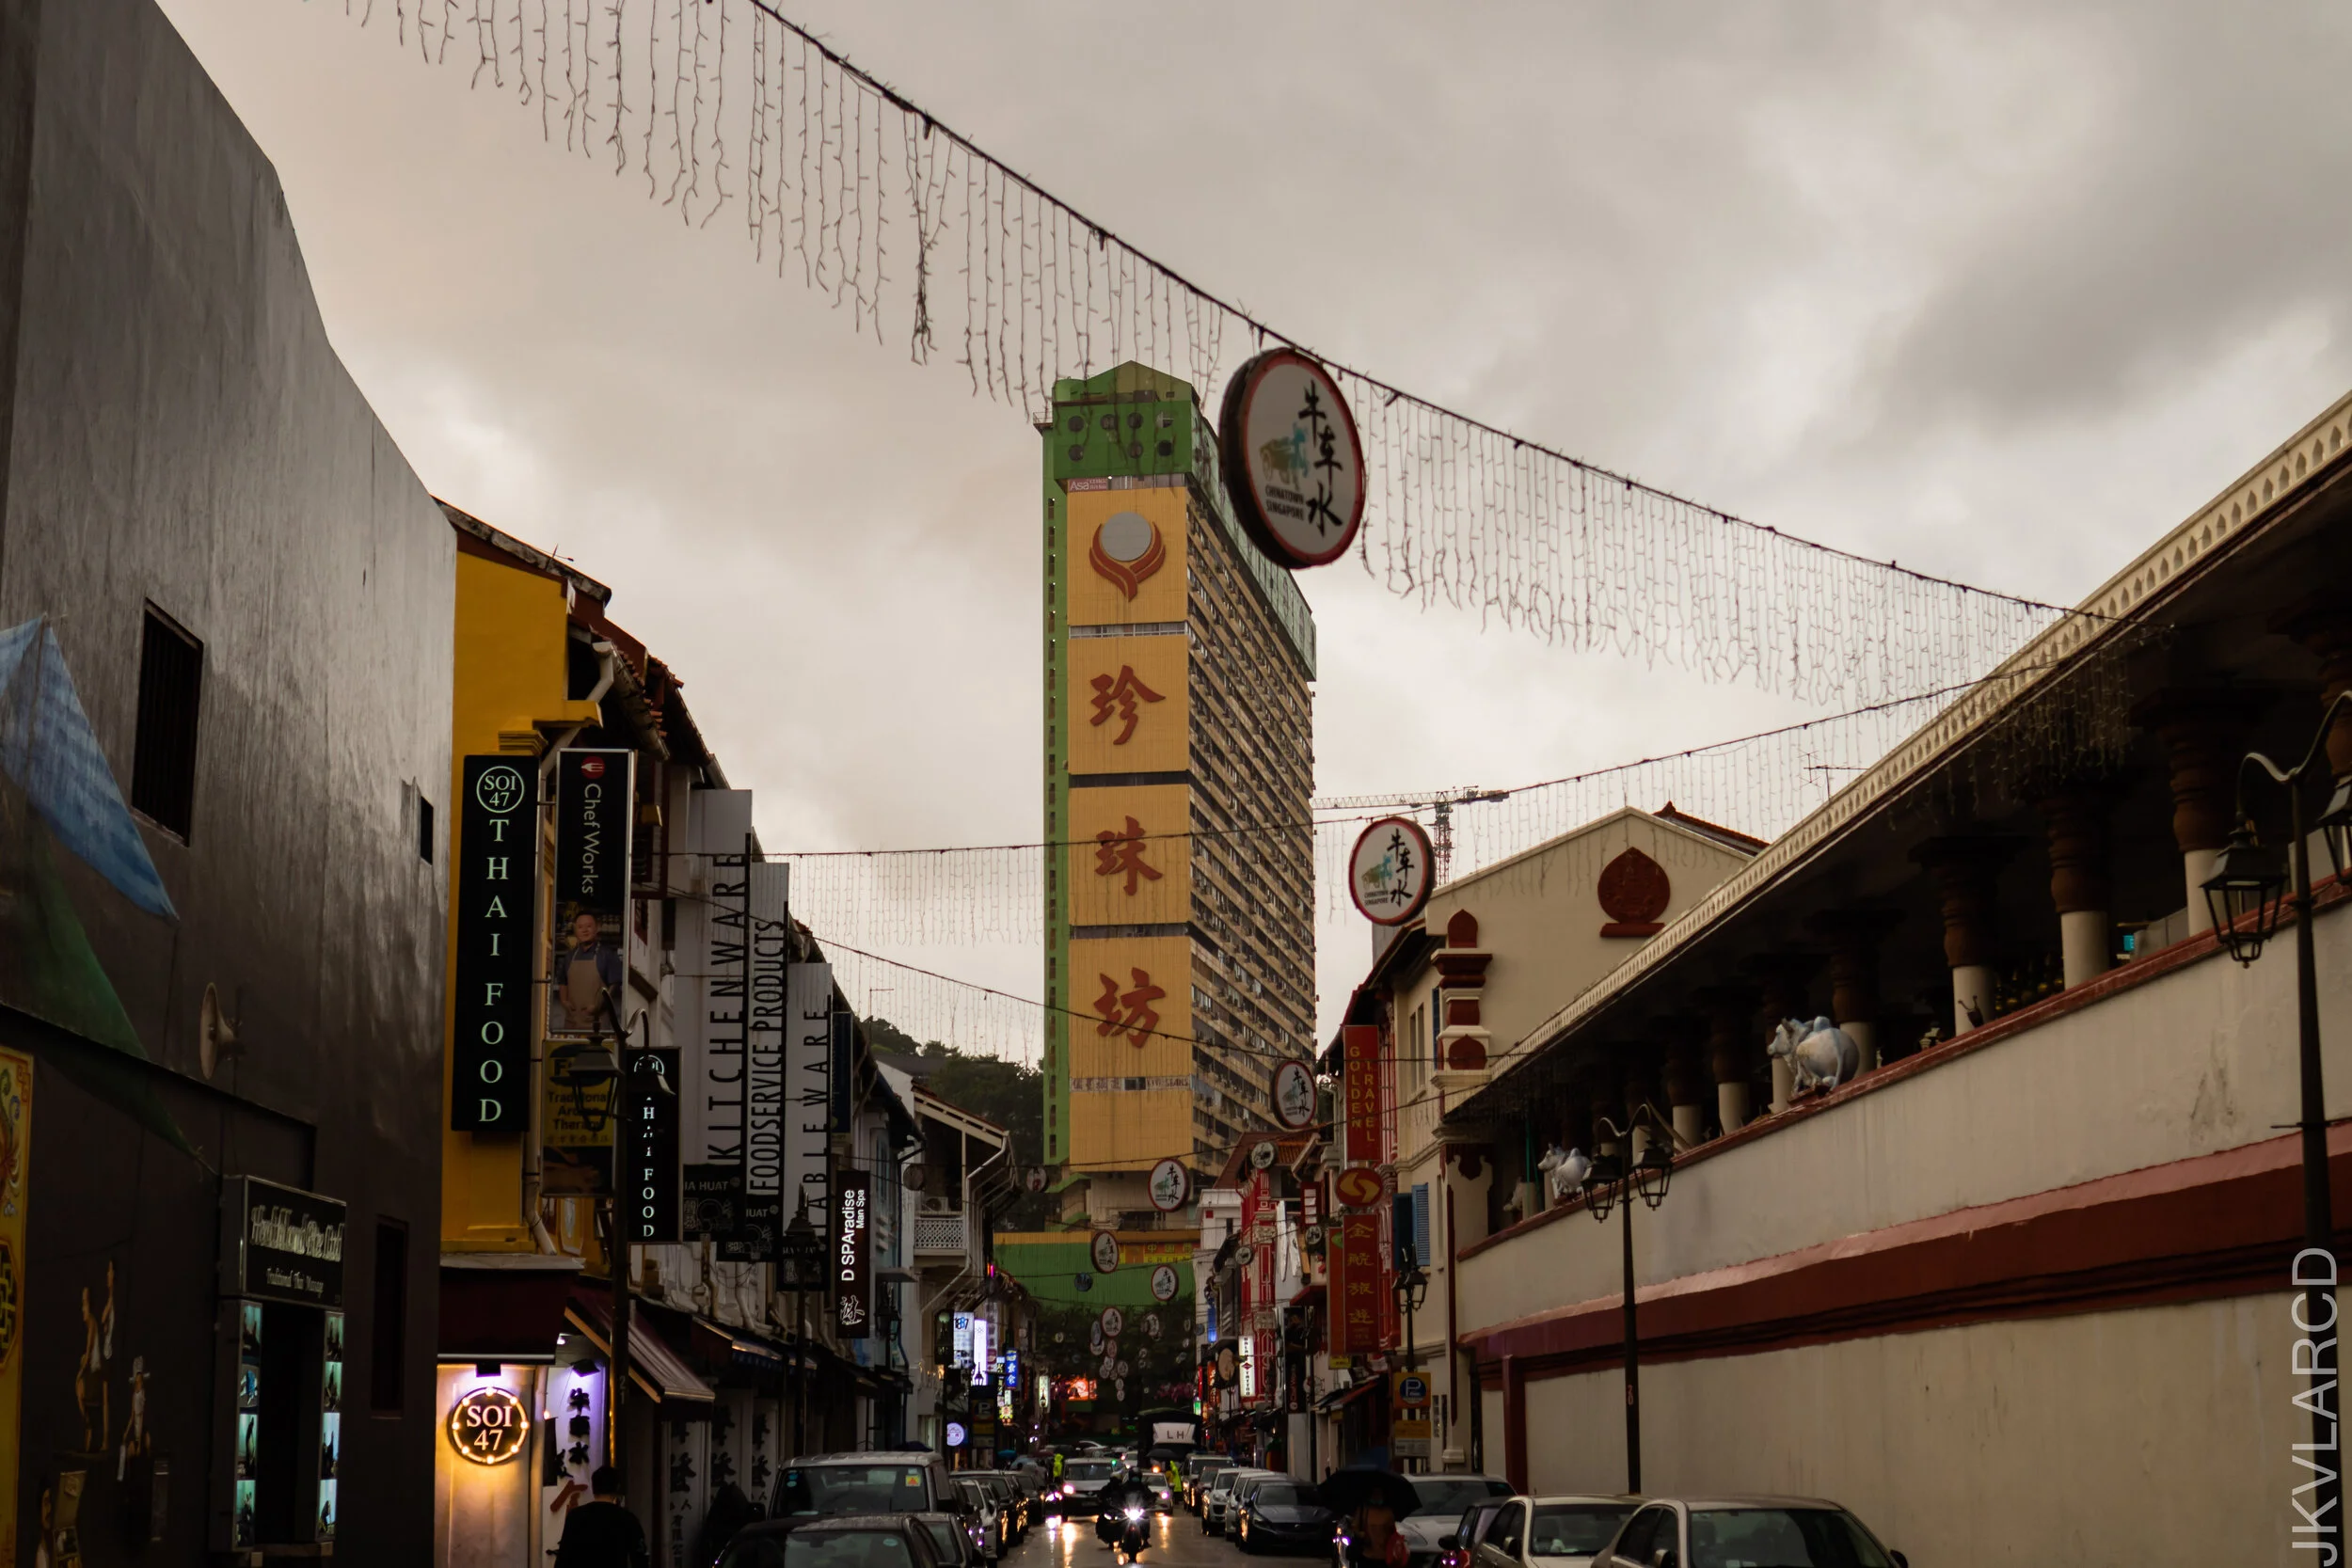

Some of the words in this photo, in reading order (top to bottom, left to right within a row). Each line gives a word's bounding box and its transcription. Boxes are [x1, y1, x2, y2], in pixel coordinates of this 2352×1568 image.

[1264, 484, 1304, 504] CHINATOWN
[1265, 501, 1305, 521] SINGAPORE
[484, 774, 516, 791] SOI
[488, 792, 510, 807] 47
[583, 783, 602, 828] Chef
[580, 830, 602, 895] Works
[1089, 664, 1167, 1050] 珍珠坊
[484, 818, 510, 958] THAI
[751, 920, 787, 1032] PRODUCTS
[707, 854, 745, 1161] KITCHENWARE
[478, 983, 504, 1122] FOOD
[1349, 1046, 1361, 1129] GOLDEN
[1364, 1059, 1375, 1142] TRAVEL
[750, 1043, 782, 1190] FOODSERVICE
[643, 1168, 656, 1238] FOOD
[698, 1180, 731, 1192] HUAT
[855, 1188, 866, 1208] Spa
[840, 1188, 855, 1266] SPAradise
[856, 1208, 865, 1229] Man
[840, 1268, 855, 1282] D
[466, 1404, 513, 1429] SOI
[473, 1430, 503, 1451] 47
